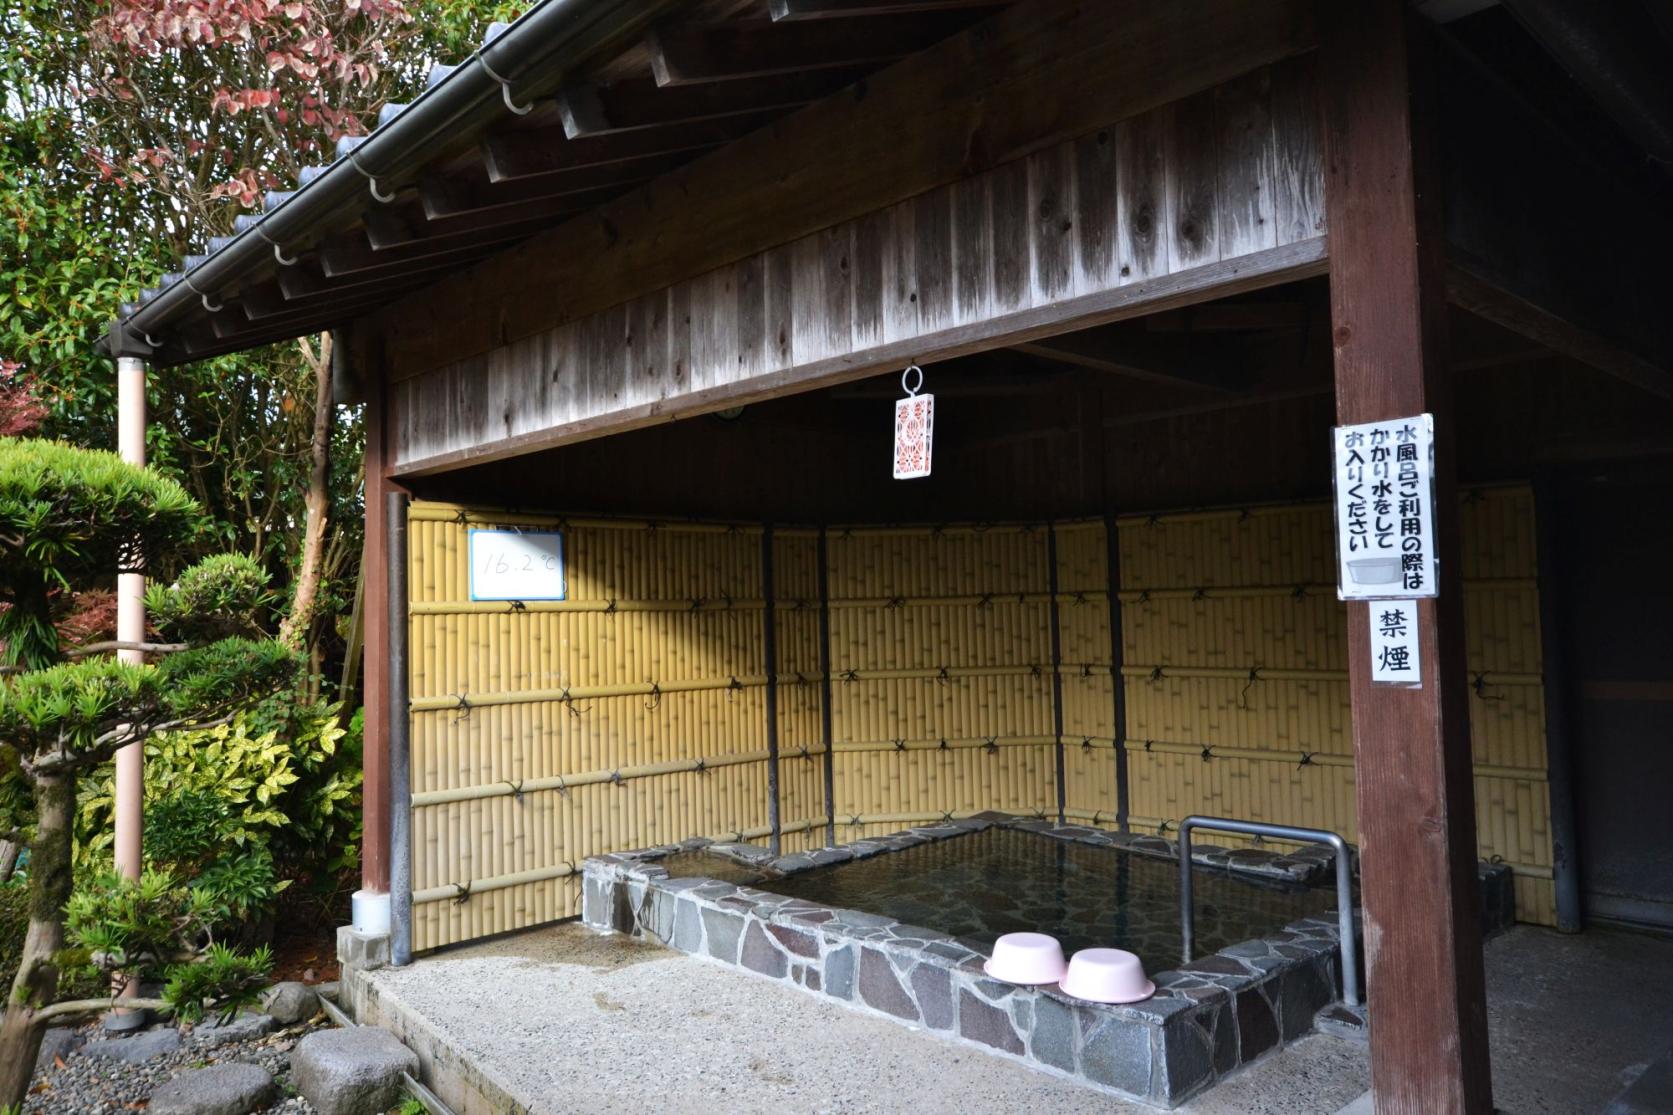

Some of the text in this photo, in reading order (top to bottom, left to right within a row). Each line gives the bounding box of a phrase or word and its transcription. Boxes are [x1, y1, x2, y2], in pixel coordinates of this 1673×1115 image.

[1345, 431, 1368, 552] お入りください
[1370, 428, 1394, 549] かかり水をして
[1396, 424, 1424, 590] 水風呂ご利用の際は
[1378, 608, 1411, 672] 禁煙
